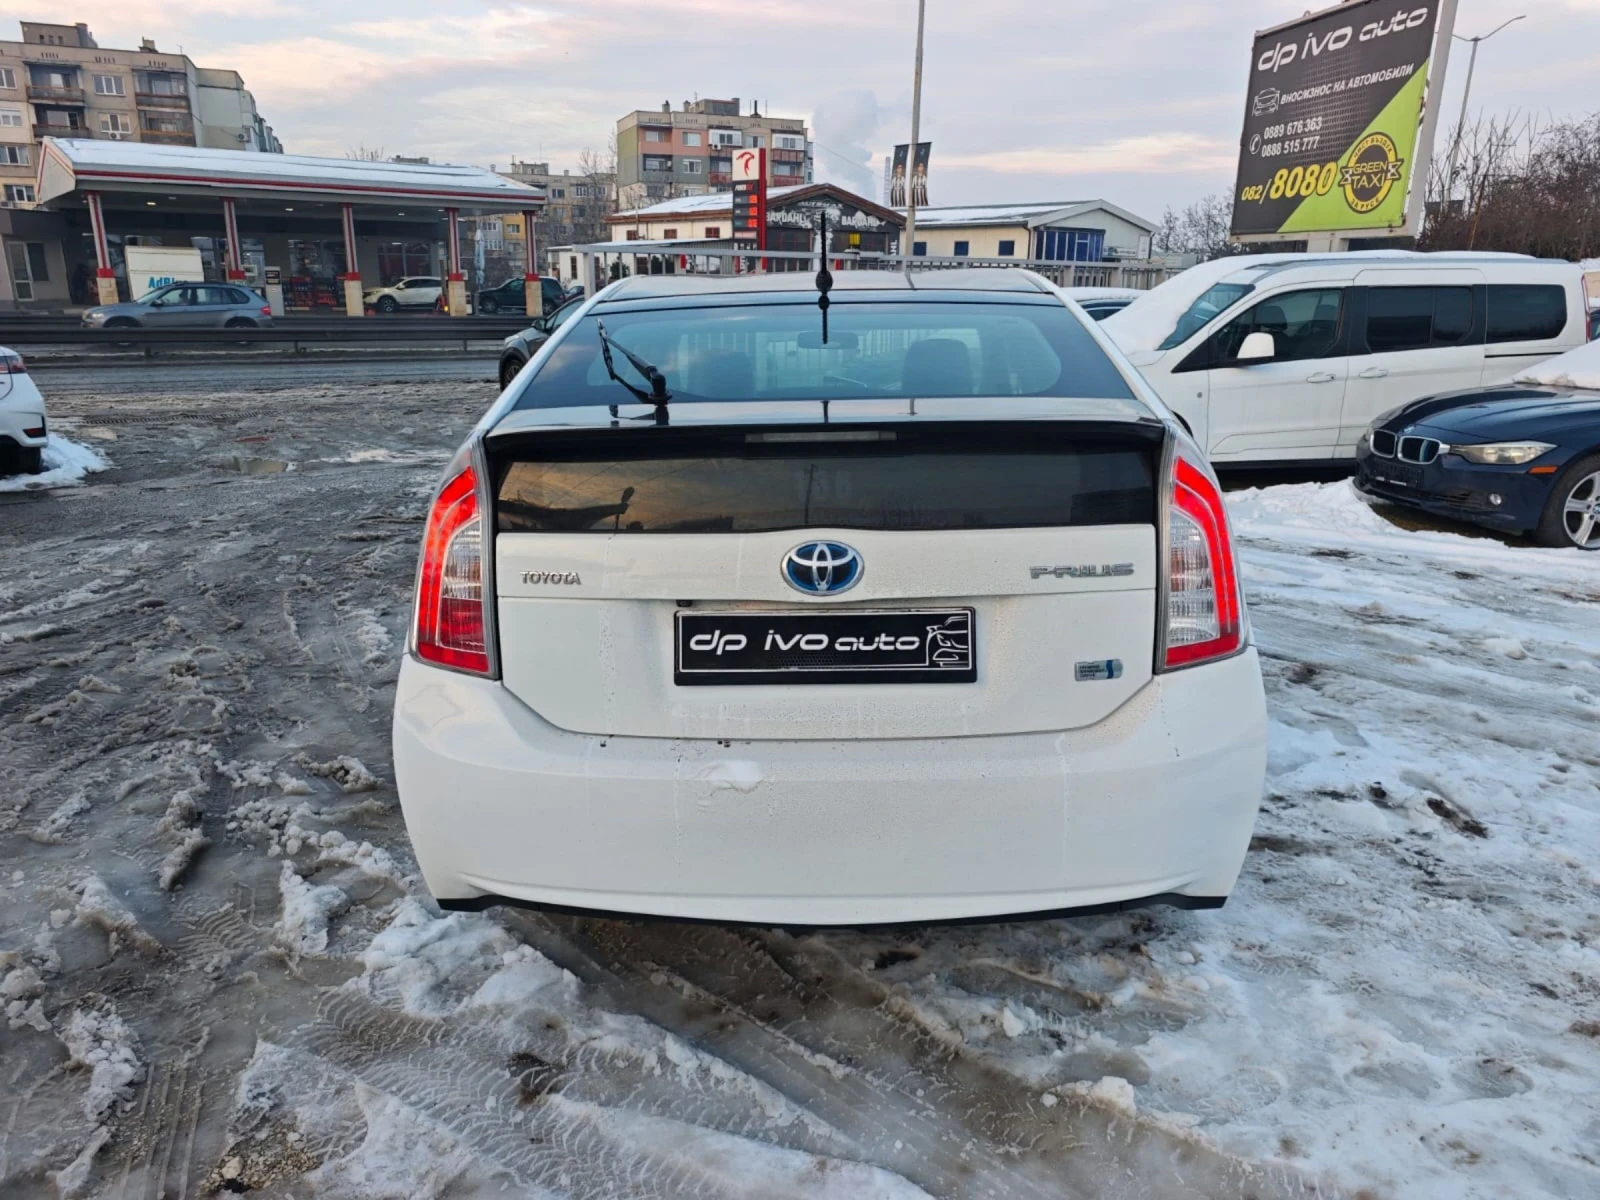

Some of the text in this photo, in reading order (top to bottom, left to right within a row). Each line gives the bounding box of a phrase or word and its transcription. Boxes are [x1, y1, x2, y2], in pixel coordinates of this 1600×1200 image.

[1258, 8, 1428, 72] dp ivo auto
[1332, 80, 1345, 92] НА
[1347, 63, 1415, 89] АВТОМОБИЛИ
[1263, 116, 1323, 140] 0889 676 363
[1283, 139, 1300, 154] 515
[1302, 135, 1320, 151] 777
[1353, 160, 1388, 174] GREEN
[1351, 172, 1385, 190] TAXI
[519, 571, 582, 586] TOYOTA
[1030, 563, 1135, 579] PRIUS
[689, 630, 920, 656] dp ivo auto
